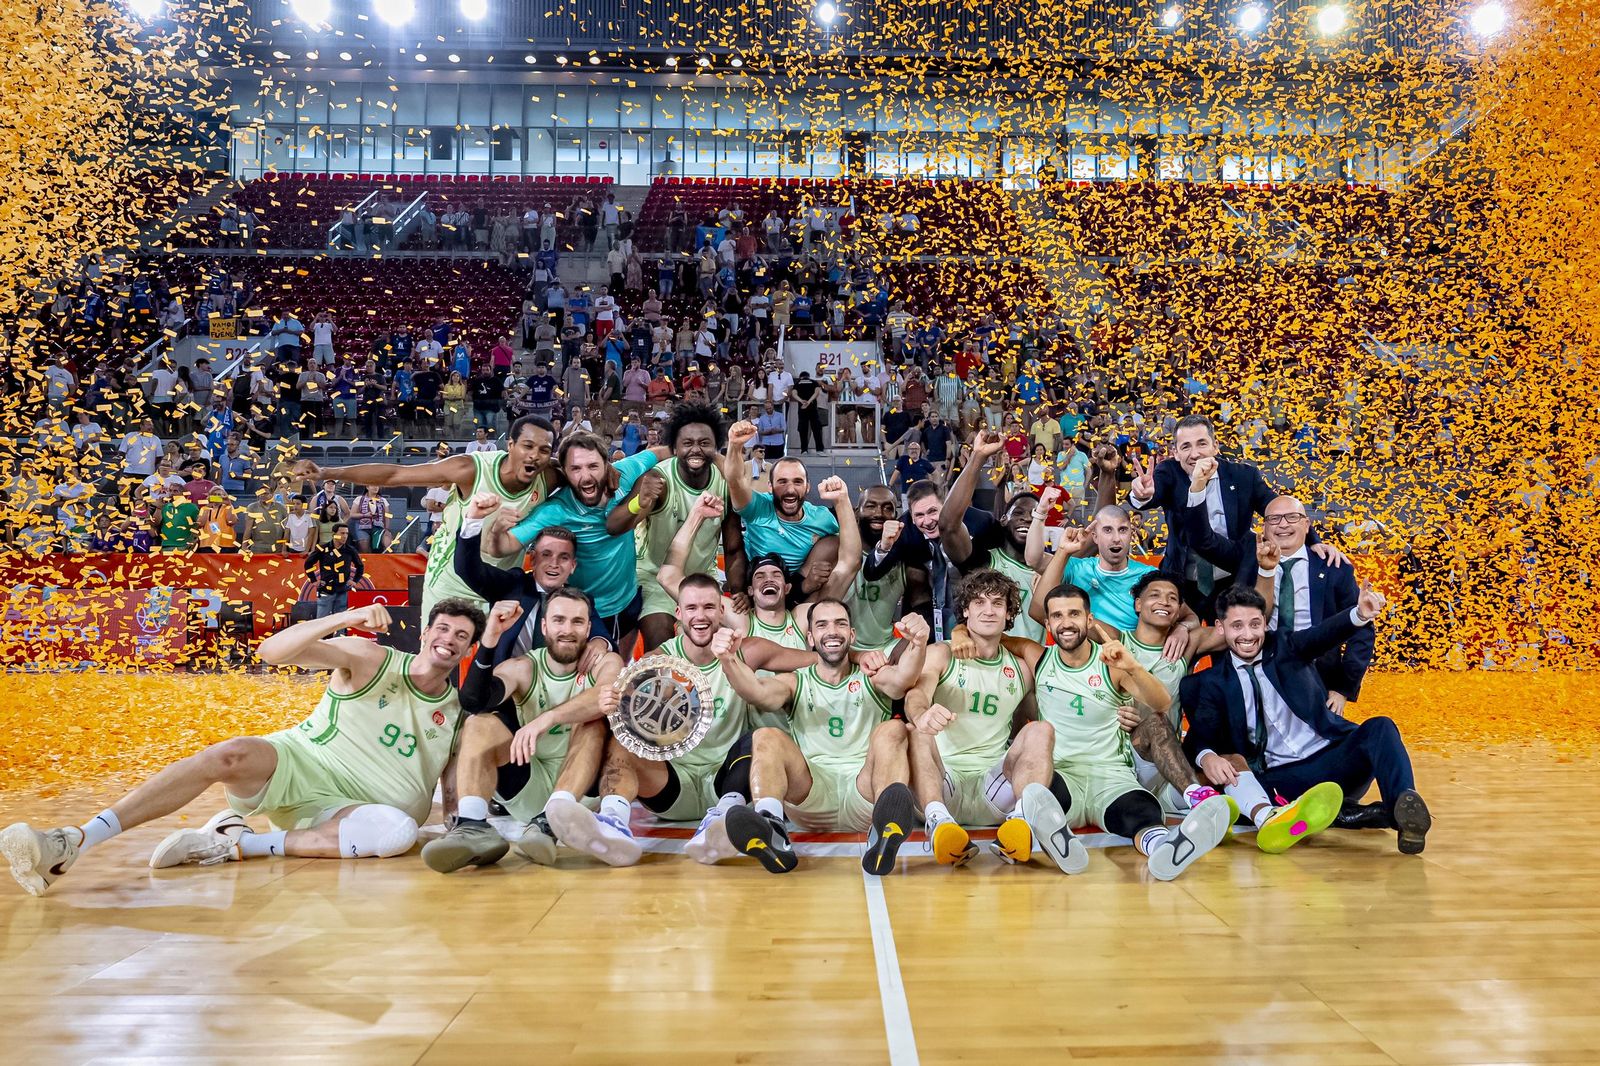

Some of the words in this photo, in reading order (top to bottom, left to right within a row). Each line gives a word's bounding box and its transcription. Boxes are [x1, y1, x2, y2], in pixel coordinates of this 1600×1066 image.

[819, 353, 841, 365] B21
[859, 583, 881, 602] 13
[969, 691, 999, 716] 16
[1069, 695, 1084, 716] 4
[828, 716, 844, 737] 8
[379, 723, 417, 757] 93
